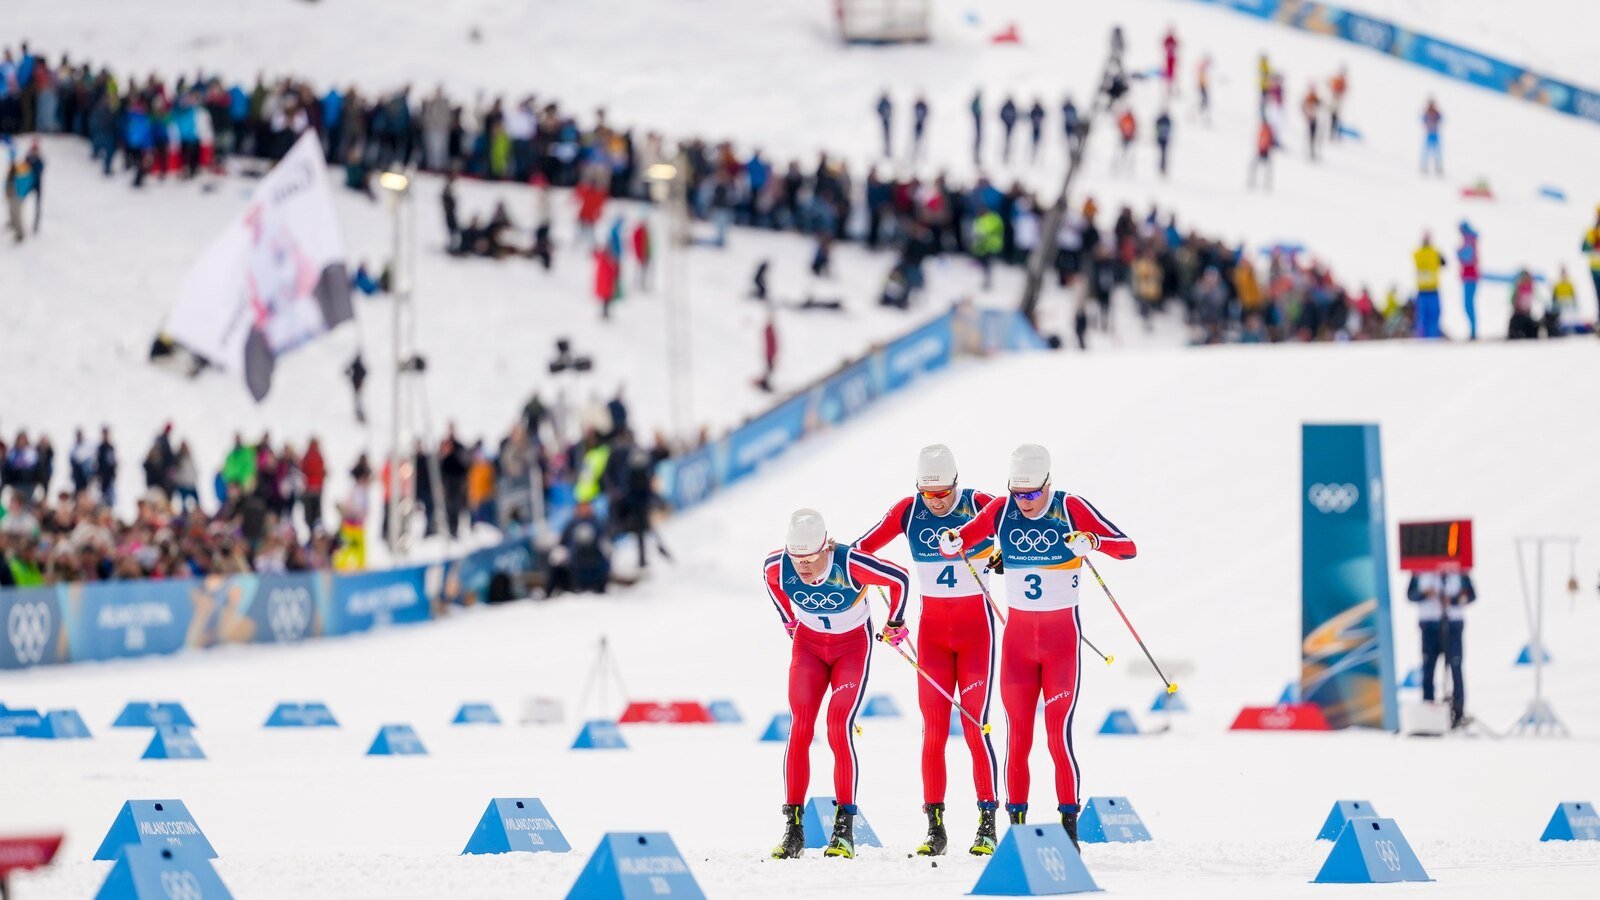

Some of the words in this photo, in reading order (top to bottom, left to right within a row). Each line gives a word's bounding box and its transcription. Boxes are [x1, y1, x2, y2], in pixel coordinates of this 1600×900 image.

[936, 565, 958, 588] 4
[1071, 574, 1079, 588] 3
[1024, 574, 1042, 600] 3
[817, 616, 832, 630] 1
[140, 821, 168, 835] MILANO
[166, 821, 200, 835] CORTINA
[505, 818, 530, 830] MILANO
[528, 818, 557, 830] CORTINA
